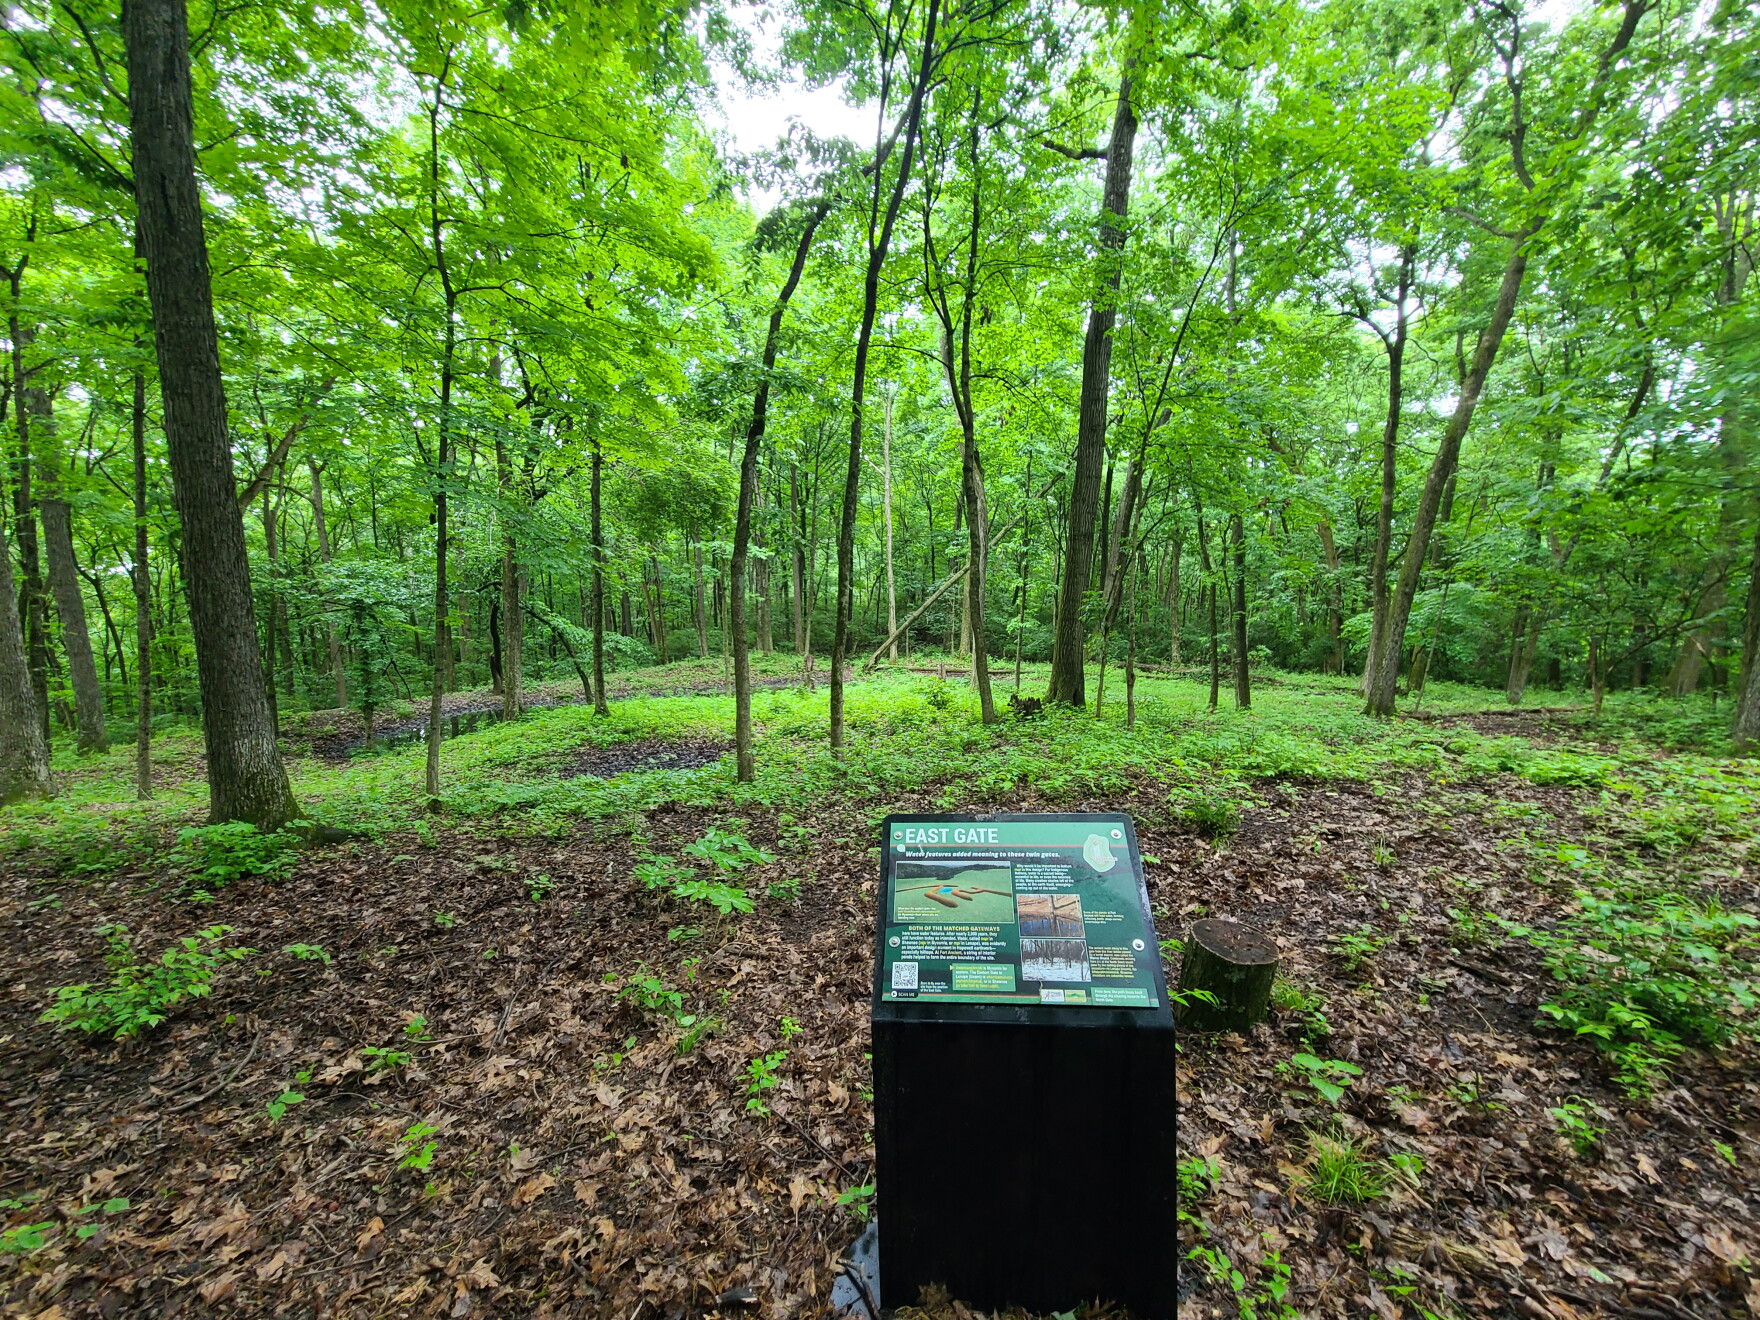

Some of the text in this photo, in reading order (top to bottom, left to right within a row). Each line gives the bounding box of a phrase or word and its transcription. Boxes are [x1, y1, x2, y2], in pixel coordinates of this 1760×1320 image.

[905, 828, 999, 844] EAST GATE
[925, 851, 952, 859] features
